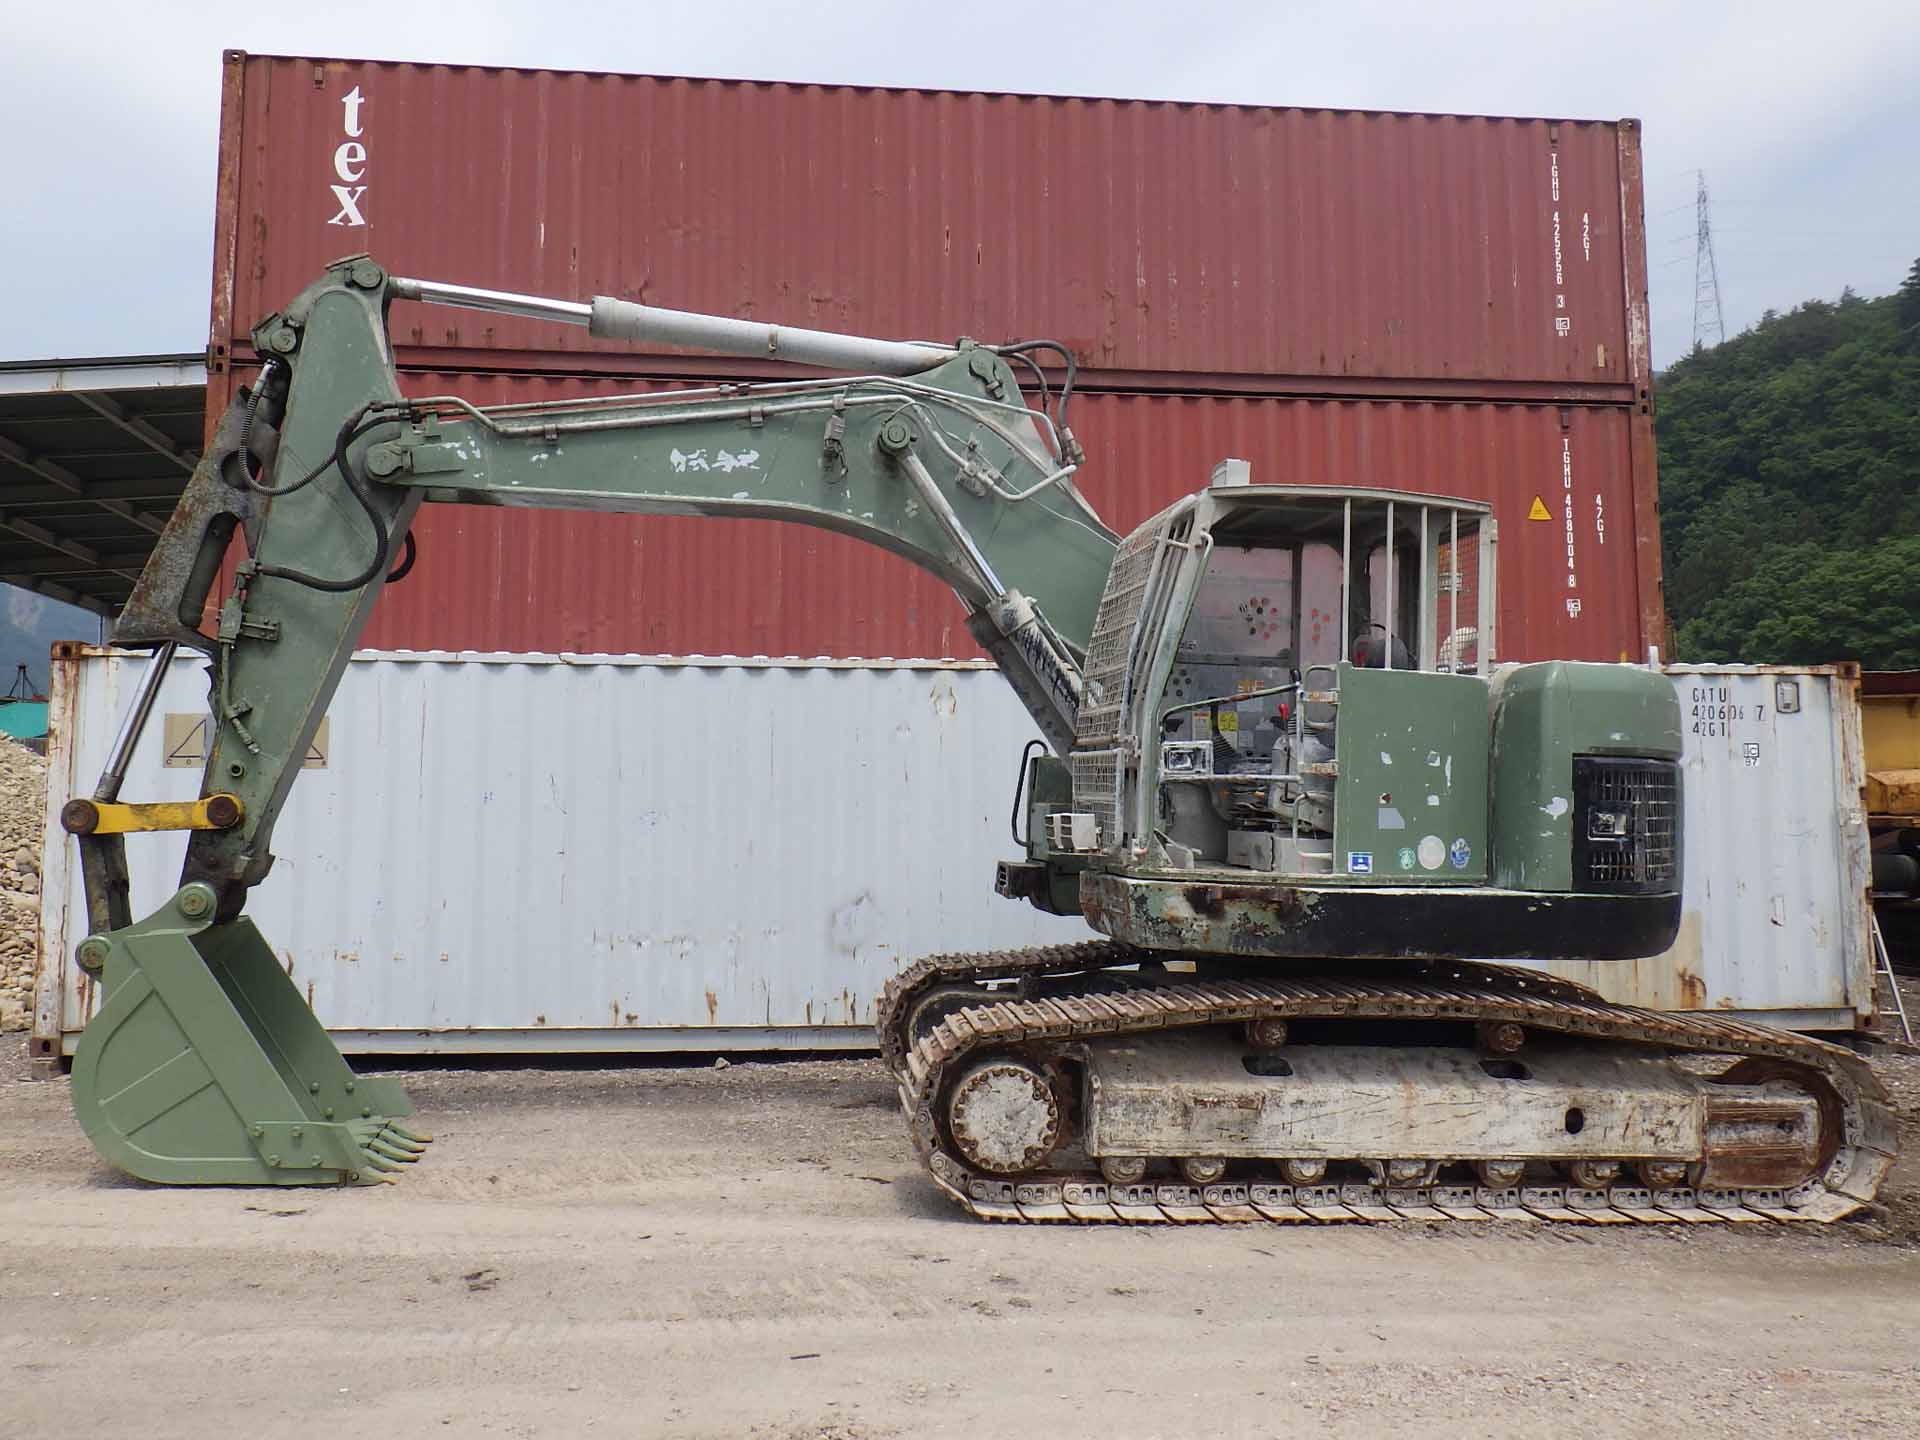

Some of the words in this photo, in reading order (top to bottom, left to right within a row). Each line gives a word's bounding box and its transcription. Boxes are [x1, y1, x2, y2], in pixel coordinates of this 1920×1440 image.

[327, 86, 368, 226] tex
[1551, 153, 1559, 201] TGHU
[1553, 211, 1563, 285] 425556
[1582, 212, 1590, 261] 42G1
[1557, 295, 1565, 308] 3
[1563, 438, 1571, 488] TGHU
[1565, 493, 1575, 569] 468004
[1595, 494, 1604, 544] 42G1
[1568, 574, 1576, 588] 8
[1692, 687, 1727, 703] GATU
[1692, 704, 1744, 720] 420606
[1756, 704, 1764, 720] 7
[1692, 722, 1725, 736] 42G1
